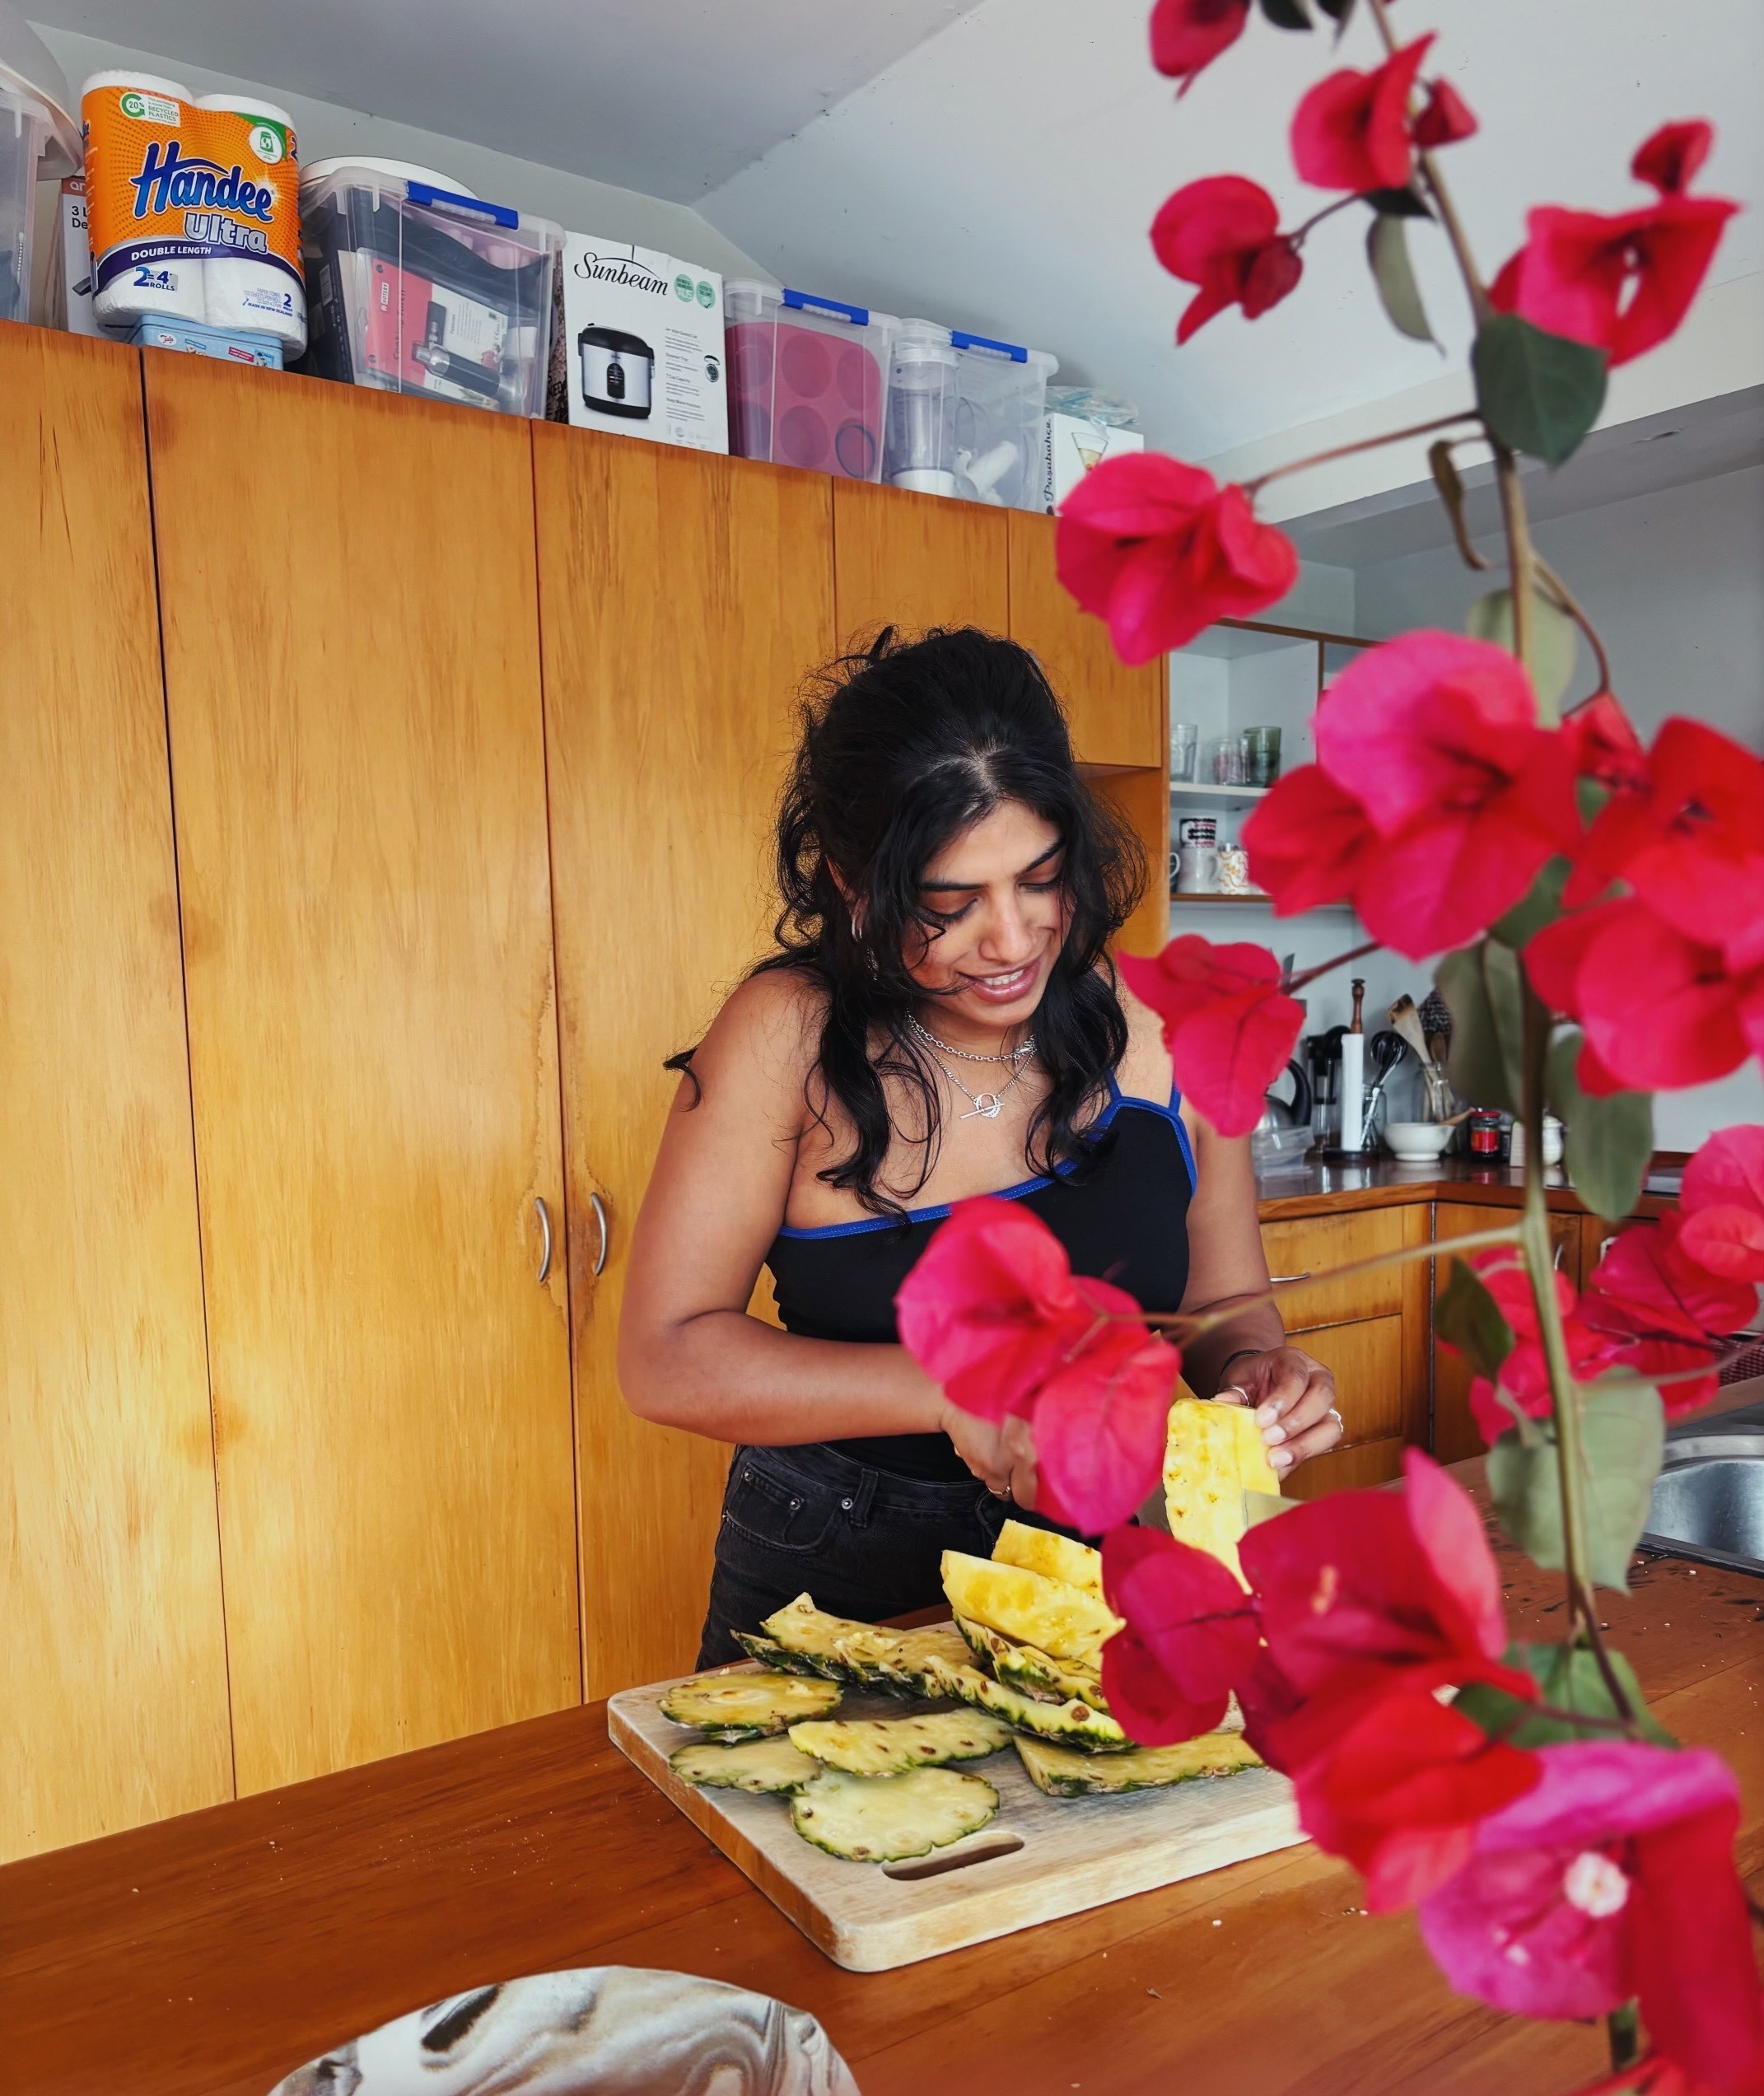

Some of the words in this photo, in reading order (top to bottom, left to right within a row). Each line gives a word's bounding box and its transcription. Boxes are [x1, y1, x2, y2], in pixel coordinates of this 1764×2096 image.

[148, 105, 179, 116] RECYCLED
[148, 111, 176, 121] PLASTICS
[129, 140, 274, 222] Handee
[71, 205, 80, 216] 3
[184, 212, 268, 254] Ultra
[131, 246, 175, 261] DOUBLE
[177, 246, 212, 254] LENGTH
[573, 252, 669, 296] Sunbeam
[150, 282, 175, 292] ROLLS
[283, 293, 291, 307] 2
